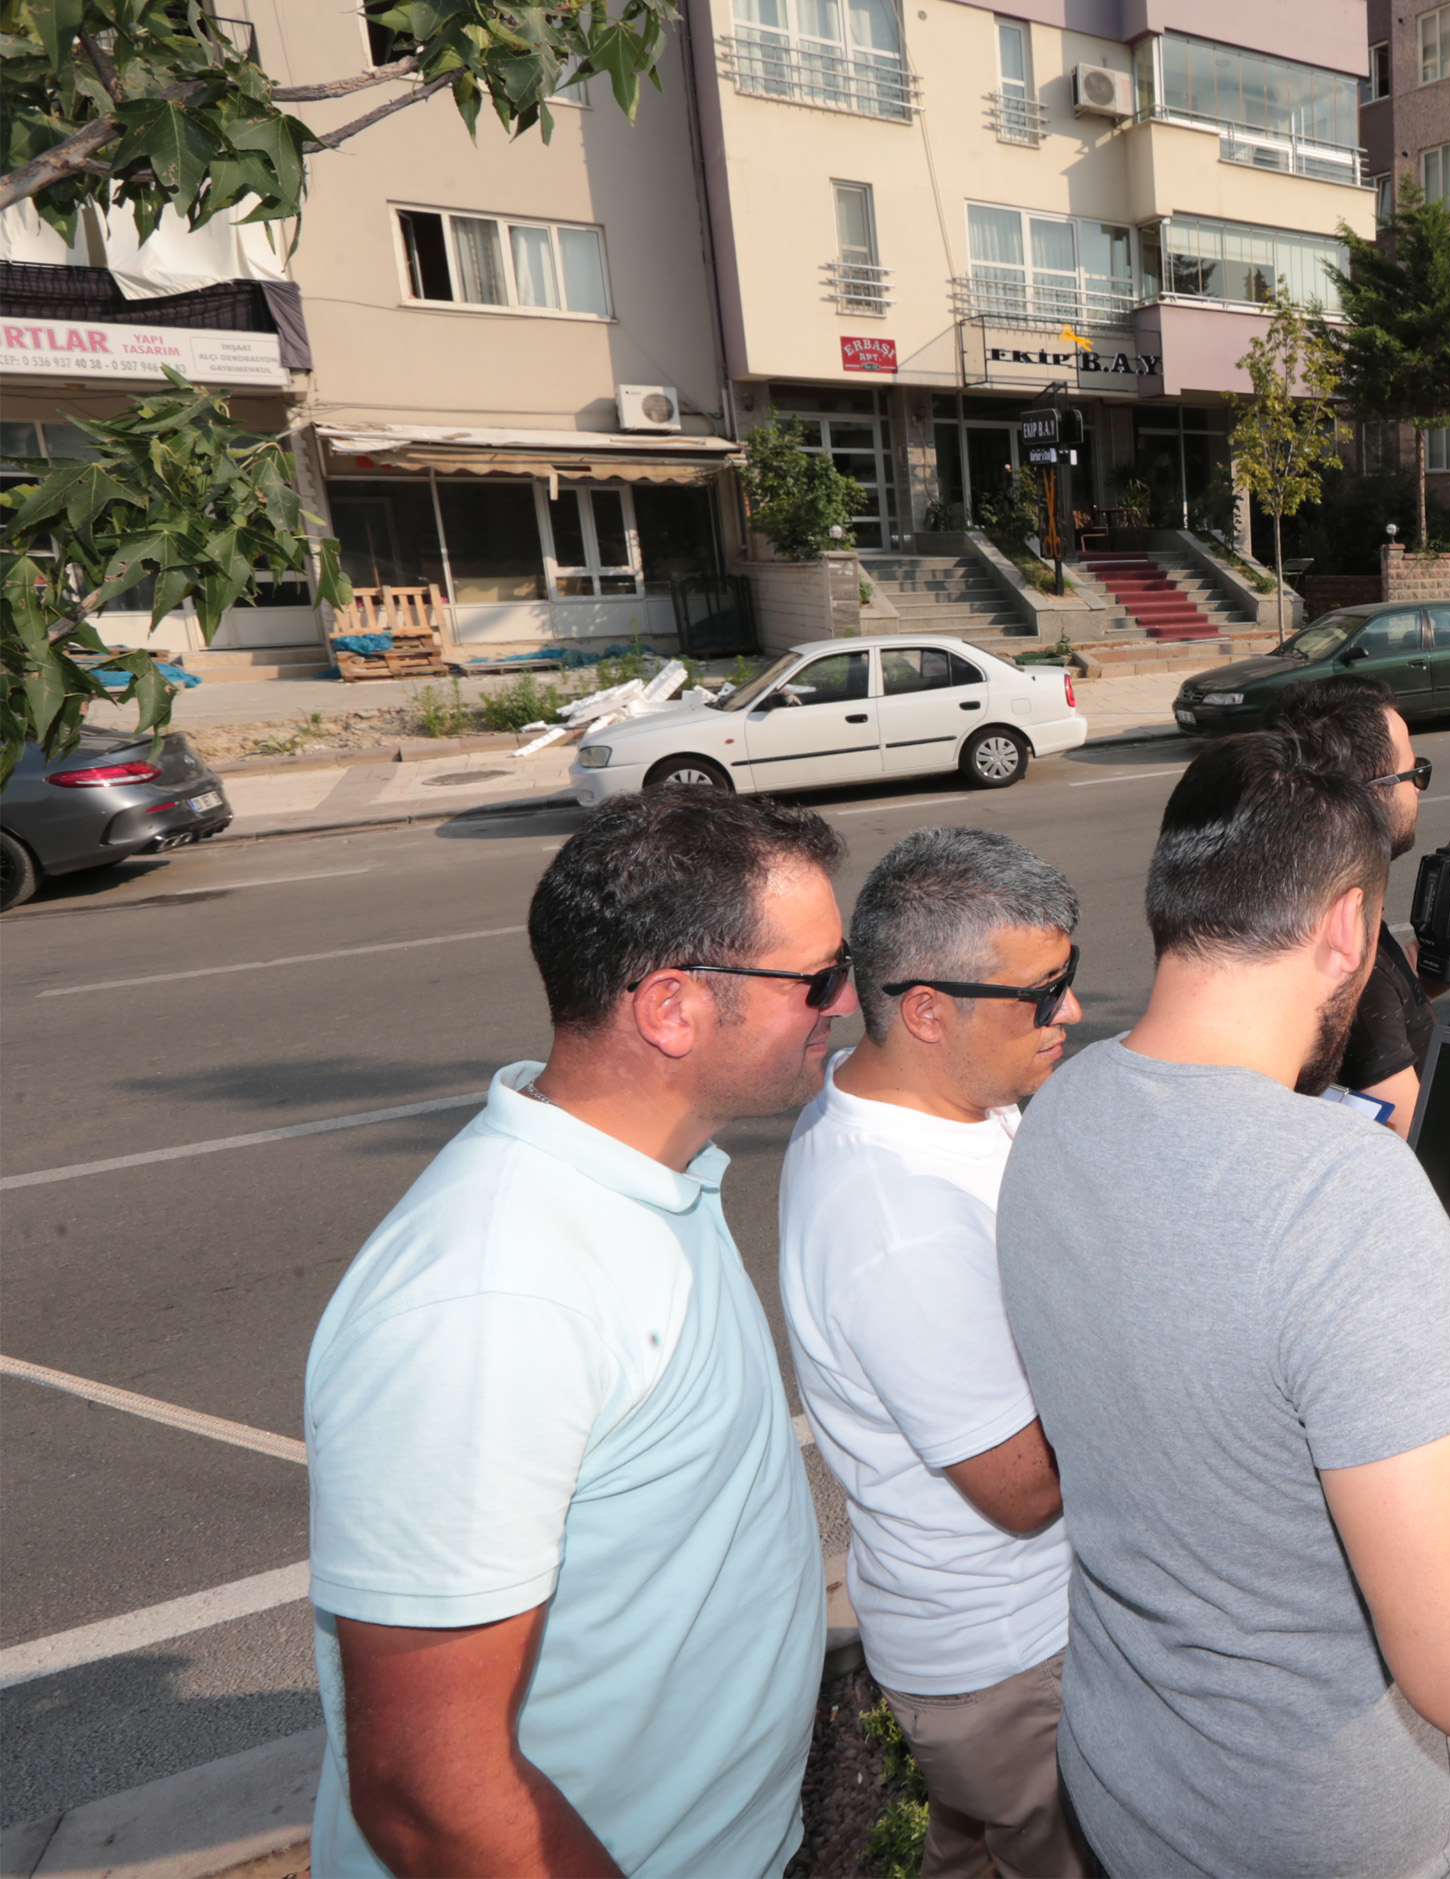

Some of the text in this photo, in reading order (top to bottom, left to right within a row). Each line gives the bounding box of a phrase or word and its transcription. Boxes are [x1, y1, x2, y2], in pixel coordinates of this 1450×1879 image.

[0, 326, 111, 353] RTLAR
[133, 334, 163, 345] YAPI
[122, 344, 180, 356] TASARIM
[844, 339, 896, 359] ERBAŞI
[22, 356, 29, 366] 0
[32, 356, 51, 367] 536
[53, 357, 71, 368] 937
[75, 358, 87, 369] 40
[89, 359, 102, 369] 38
[112, 360, 118, 370] 0
[121, 360, 138, 371] 507
[859, 353, 882, 362] APT.
[991, 348, 1161, 375] EKİP B.A.Y
